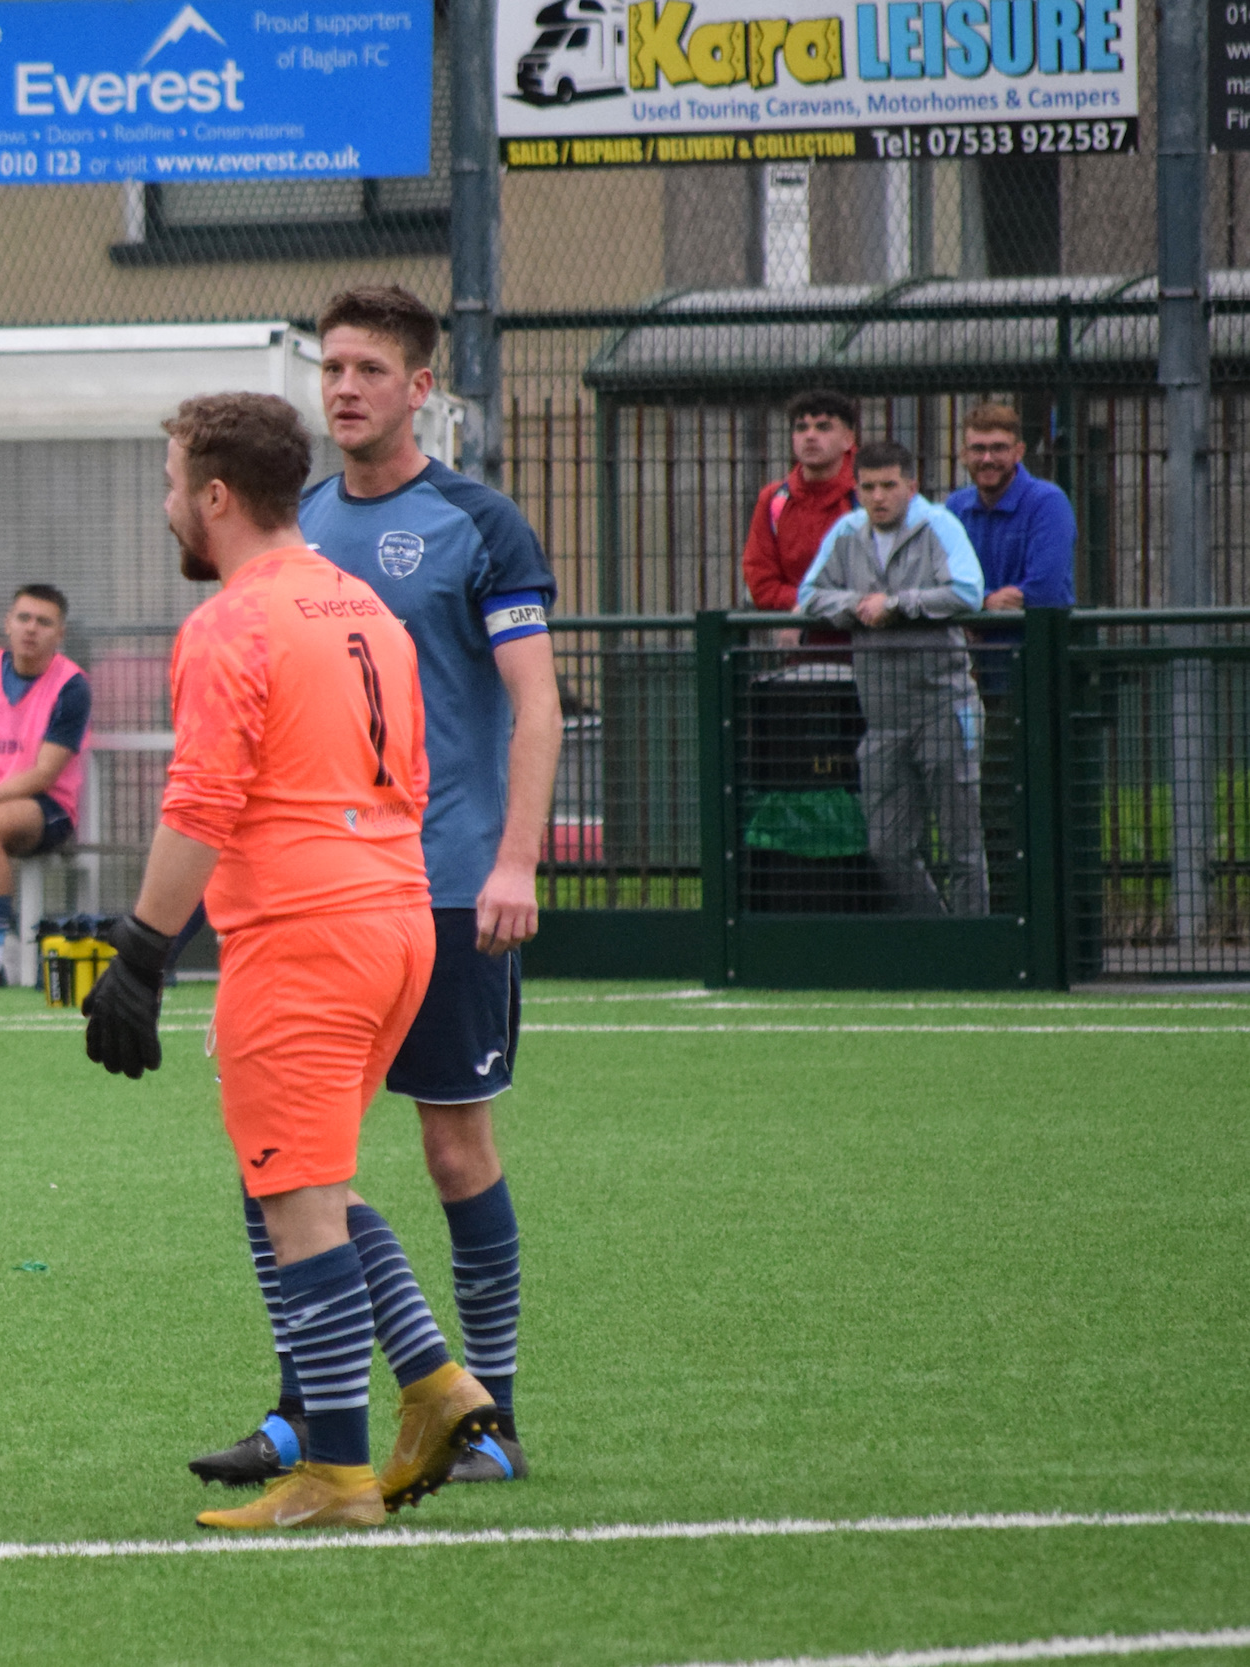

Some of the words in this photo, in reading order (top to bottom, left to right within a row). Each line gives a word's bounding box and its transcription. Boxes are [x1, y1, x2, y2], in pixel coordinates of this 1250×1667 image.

[254, 10, 309, 33] Proud
[315, 13, 411, 37] supporters
[278, 45, 297, 69] of
[303, 46, 358, 74] Baglan
[363, 43, 389, 67] FC
[628, 0, 844, 89] Kara
[857, 0, 1123, 80] LEISURE
[16, 60, 245, 115] Everest
[632, 101, 681, 121] Used
[687, 98, 761, 122] Touring
[766, 95, 861, 118] Caravans,
[868, 90, 999, 114] Motorhomes
[1005, 88, 1021, 109] &
[1028, 87, 1120, 110] Campers
[48, 124, 95, 143] Doors
[114, 122, 174, 142] Roofline
[194, 120, 306, 141] Conservatories
[872, 128, 921, 157] Tel:
[927, 125, 1014, 155] 07533
[1020, 120, 1128, 152] 922587
[0, 151, 38, 176] 010
[48, 149, 81, 175] 123
[89, 157, 109, 174] or
[116, 153, 148, 174] visit
[155, 144, 360, 173] www.everest.co.uk
[507, 140, 558, 166] SALES
[571, 139, 643, 164] REPAIRS
[657, 137, 735, 161] DELIVERY
[753, 132, 856, 159] COLLECTION
[294, 595, 386, 620] Everest
[347, 632, 395, 787] 1
